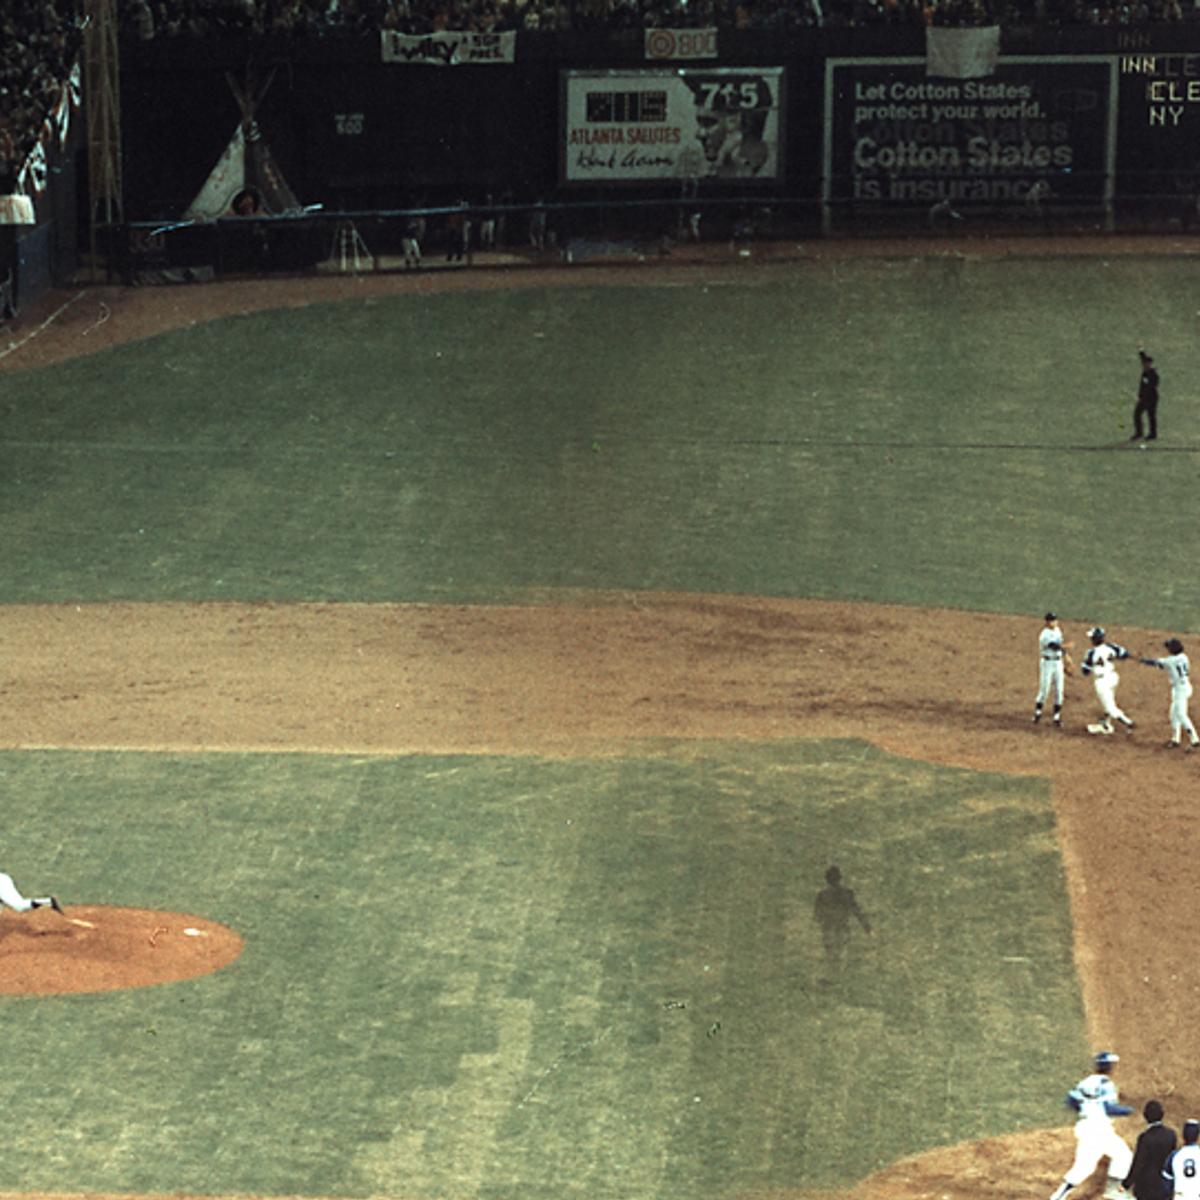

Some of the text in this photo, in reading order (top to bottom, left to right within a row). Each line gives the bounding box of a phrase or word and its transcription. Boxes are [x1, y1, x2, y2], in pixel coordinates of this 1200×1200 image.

[1122, 56, 1156, 74] INN
[855, 80, 1031, 100] Let Cotton States
[854, 100, 1046, 123] protect your world.
[1149, 105, 1185, 127] NY
[570, 127, 681, 144] ATLANTA SALUTES
[853, 136, 1073, 168] Cotton States
[854, 175, 881, 200] is
[1183, 1159, 1196, 1178] 8
